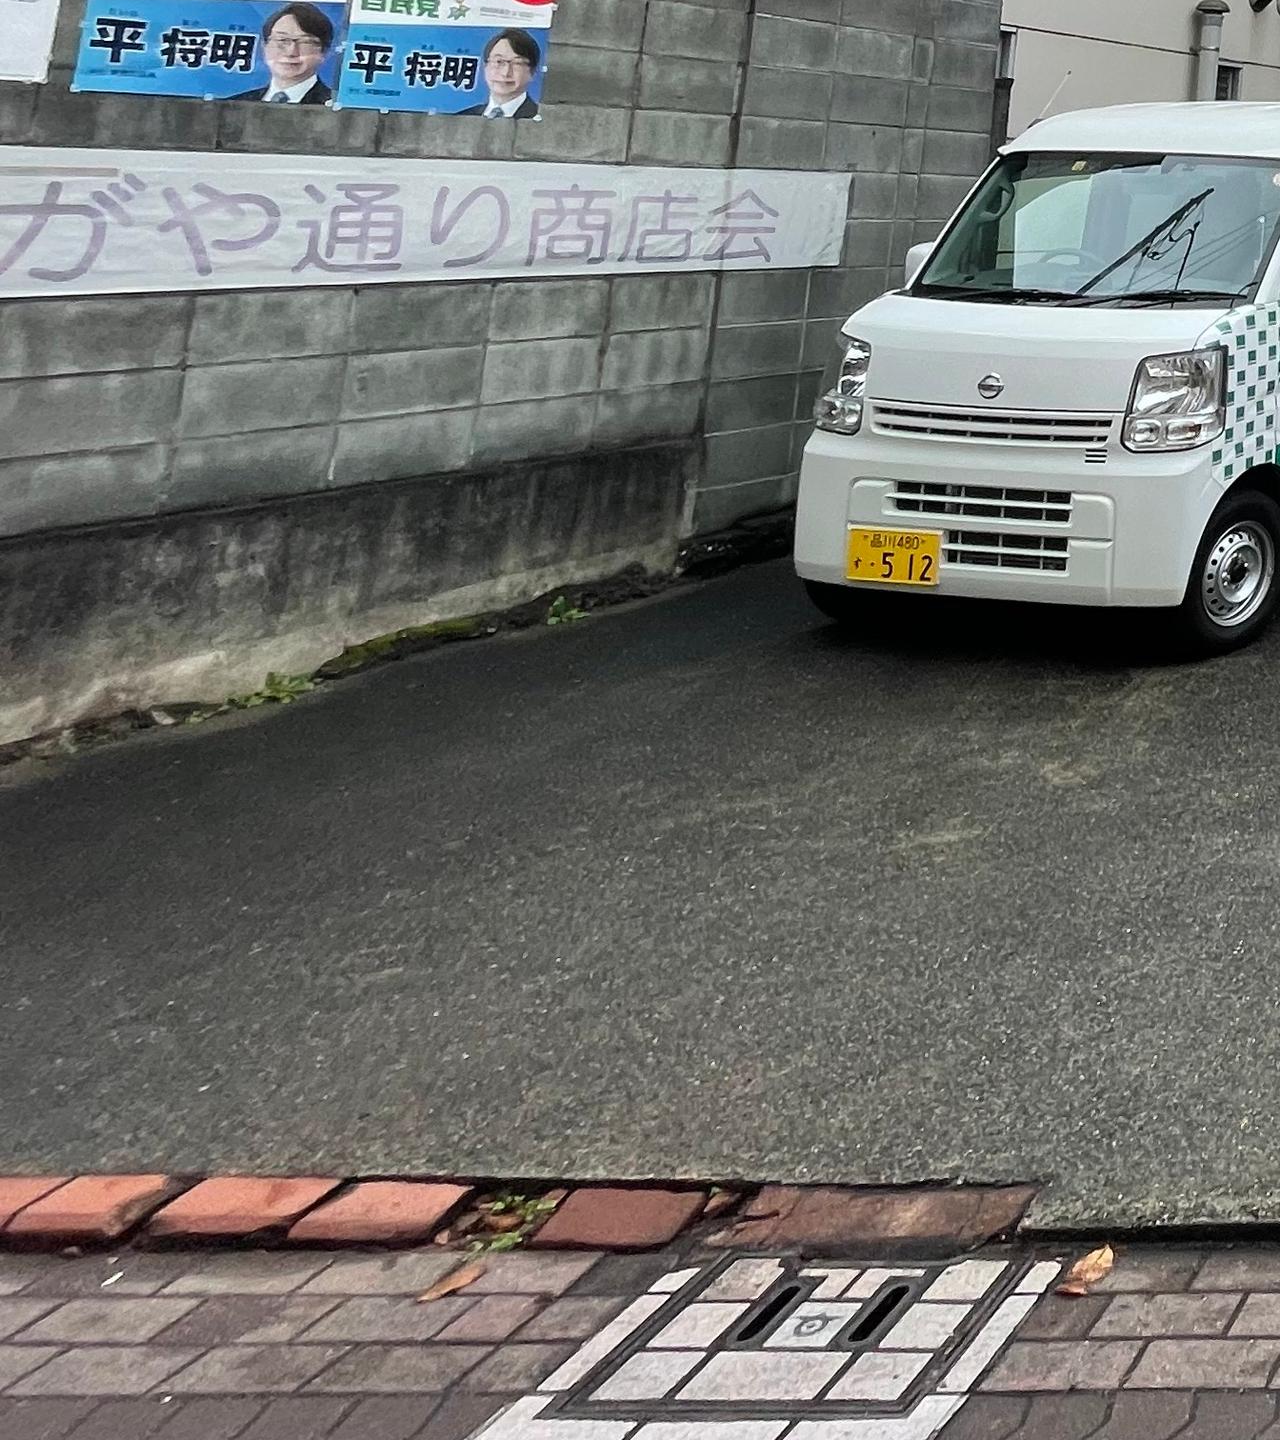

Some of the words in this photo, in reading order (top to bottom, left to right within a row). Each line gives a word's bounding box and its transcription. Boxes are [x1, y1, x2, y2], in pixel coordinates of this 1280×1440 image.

[89, 17, 148, 63] 平
[159, 27, 257, 72] 将明
[348, 42, 393, 84] 平
[404, 52, 479, 90] 将明
[0, 173, 780, 283] がや通り商店会
